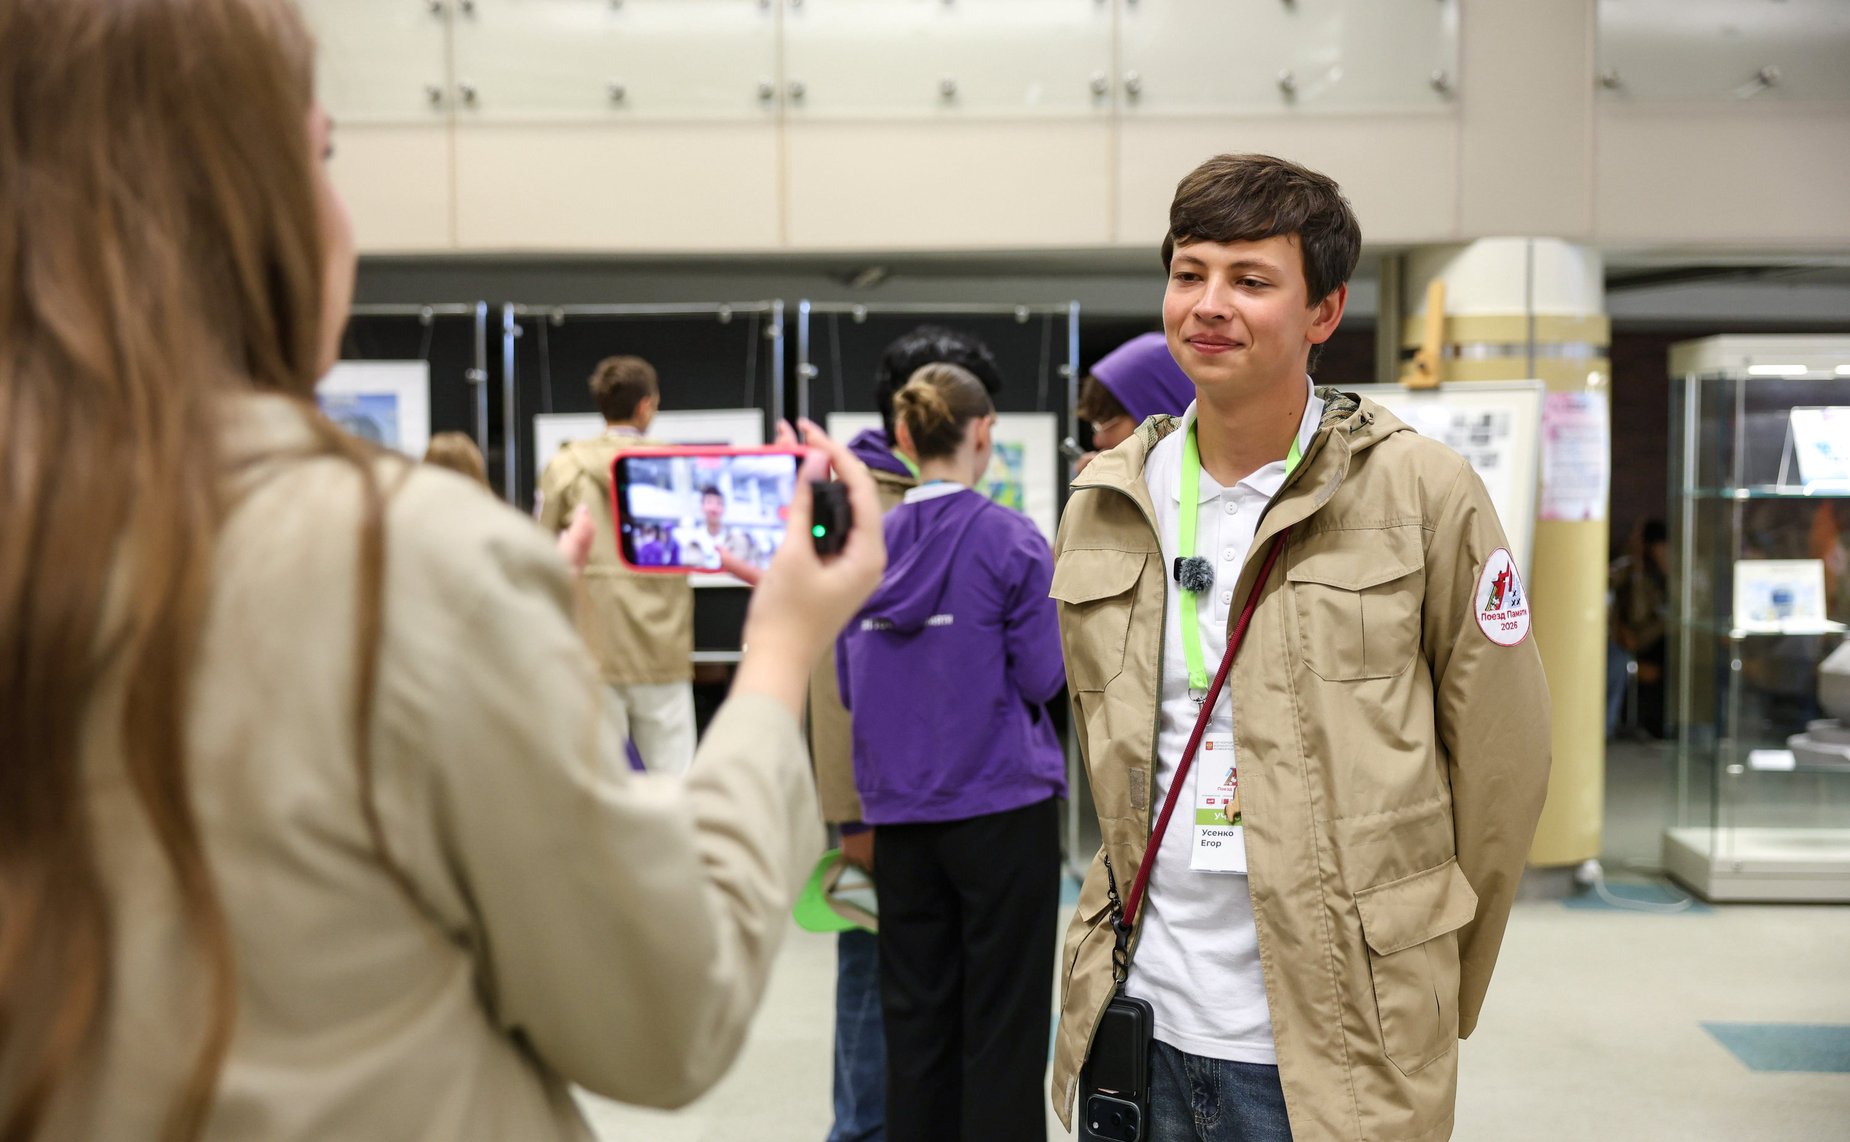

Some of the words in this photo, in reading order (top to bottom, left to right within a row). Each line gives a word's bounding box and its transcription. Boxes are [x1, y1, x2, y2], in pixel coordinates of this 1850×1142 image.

[1481, 612, 1506, 621] Поезд
[1501, 621, 1518, 631] 2026
[1201, 829, 1234, 837] Усенко
[1201, 839, 1222, 848] Егор
